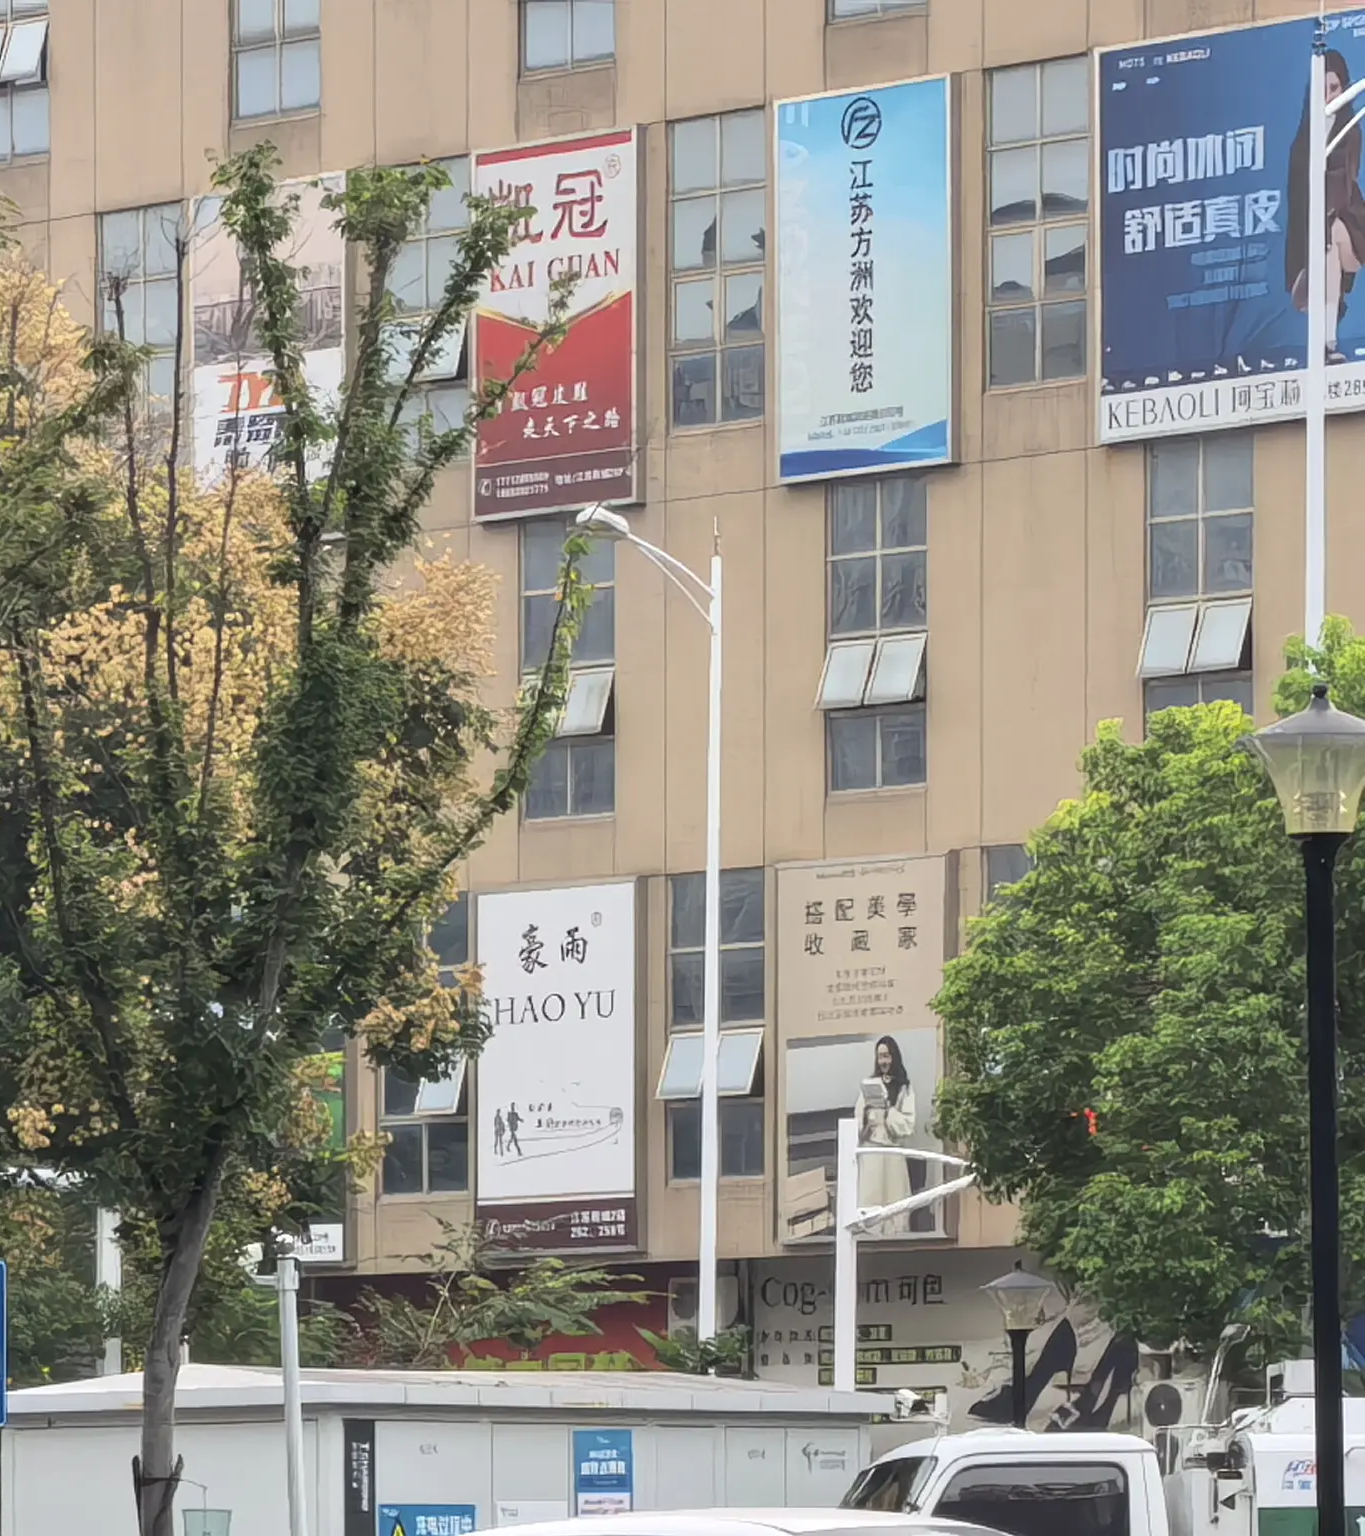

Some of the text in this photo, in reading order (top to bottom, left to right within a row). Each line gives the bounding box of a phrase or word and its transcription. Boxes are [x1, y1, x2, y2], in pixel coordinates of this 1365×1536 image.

[1124, 189, 1282, 255] 舒适真皮
[490, 259, 536, 293] KAI
[848, 159, 874, 393] 江苏方洲欢迎您
[494, 989, 616, 1026] HAO YU
